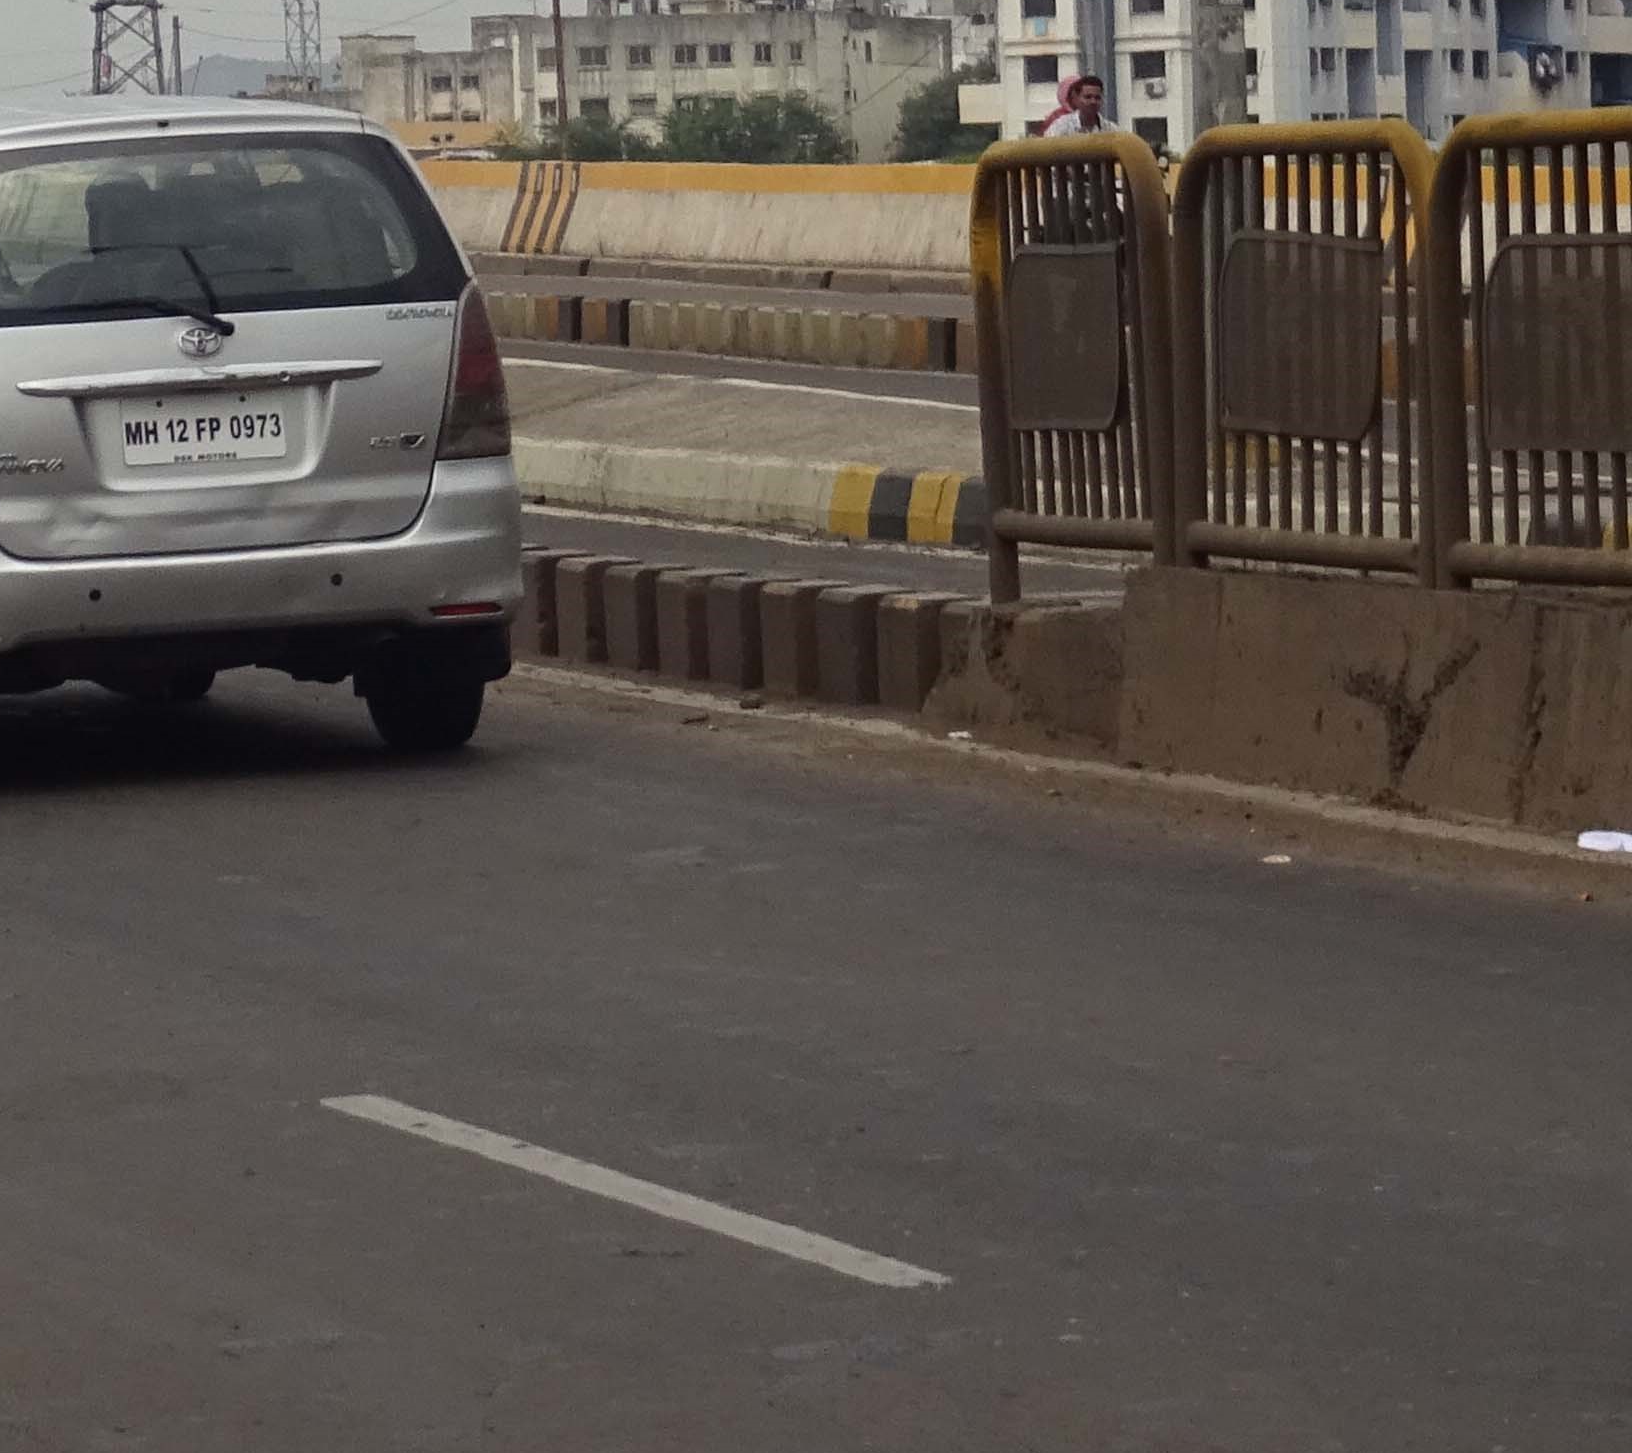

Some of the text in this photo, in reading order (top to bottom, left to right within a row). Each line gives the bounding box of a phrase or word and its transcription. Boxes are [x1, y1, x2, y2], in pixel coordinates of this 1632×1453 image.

[125, 413, 282, 445] MH 12 FP 0973
